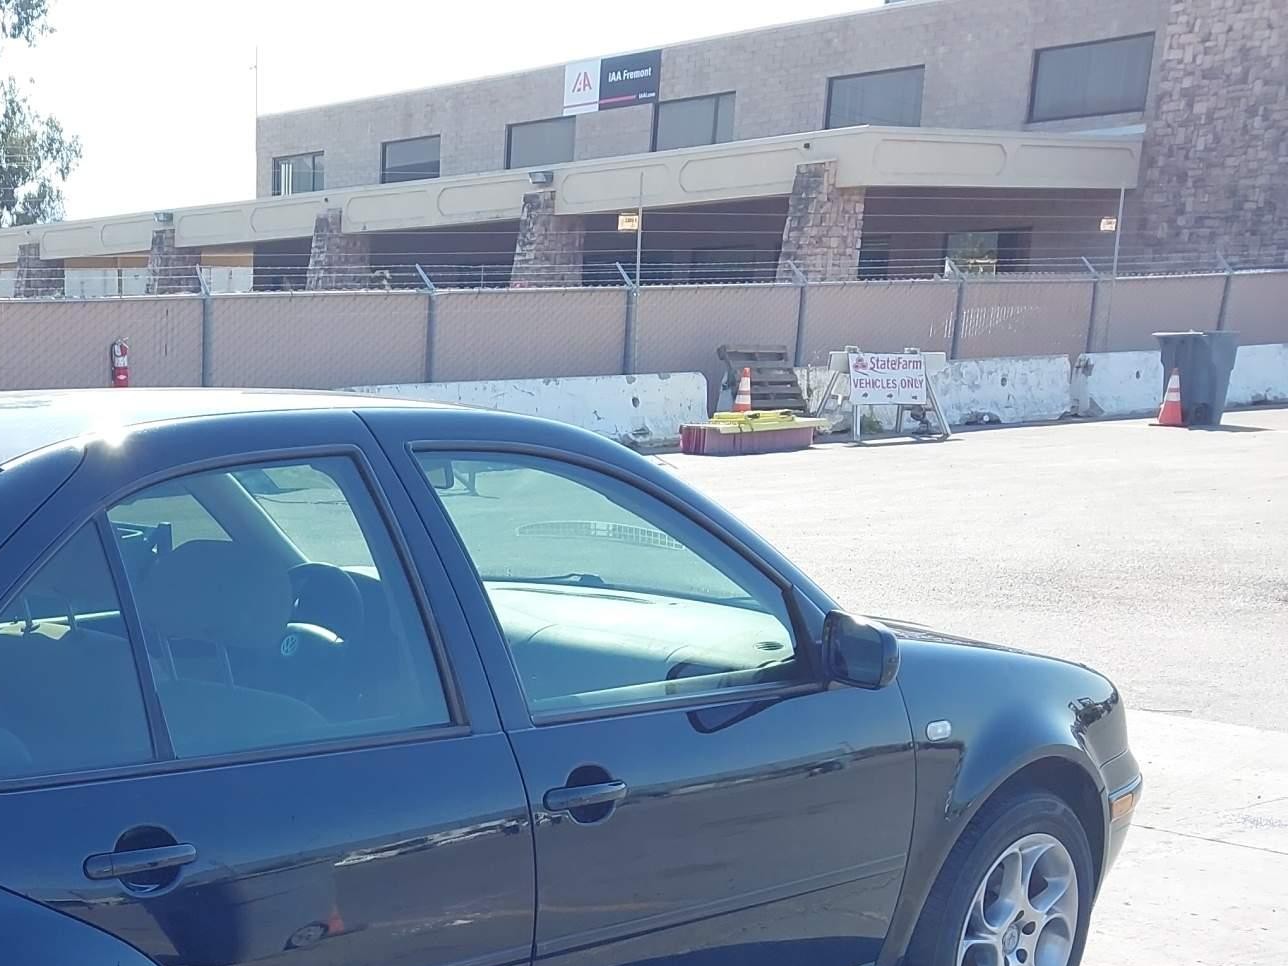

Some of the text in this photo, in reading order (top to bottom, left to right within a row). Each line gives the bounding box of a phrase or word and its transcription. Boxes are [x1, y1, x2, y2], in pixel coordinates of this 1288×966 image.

[609, 67, 652, 83] IAA Fremont
[853, 377, 924, 389] VEHICLES ONLY
